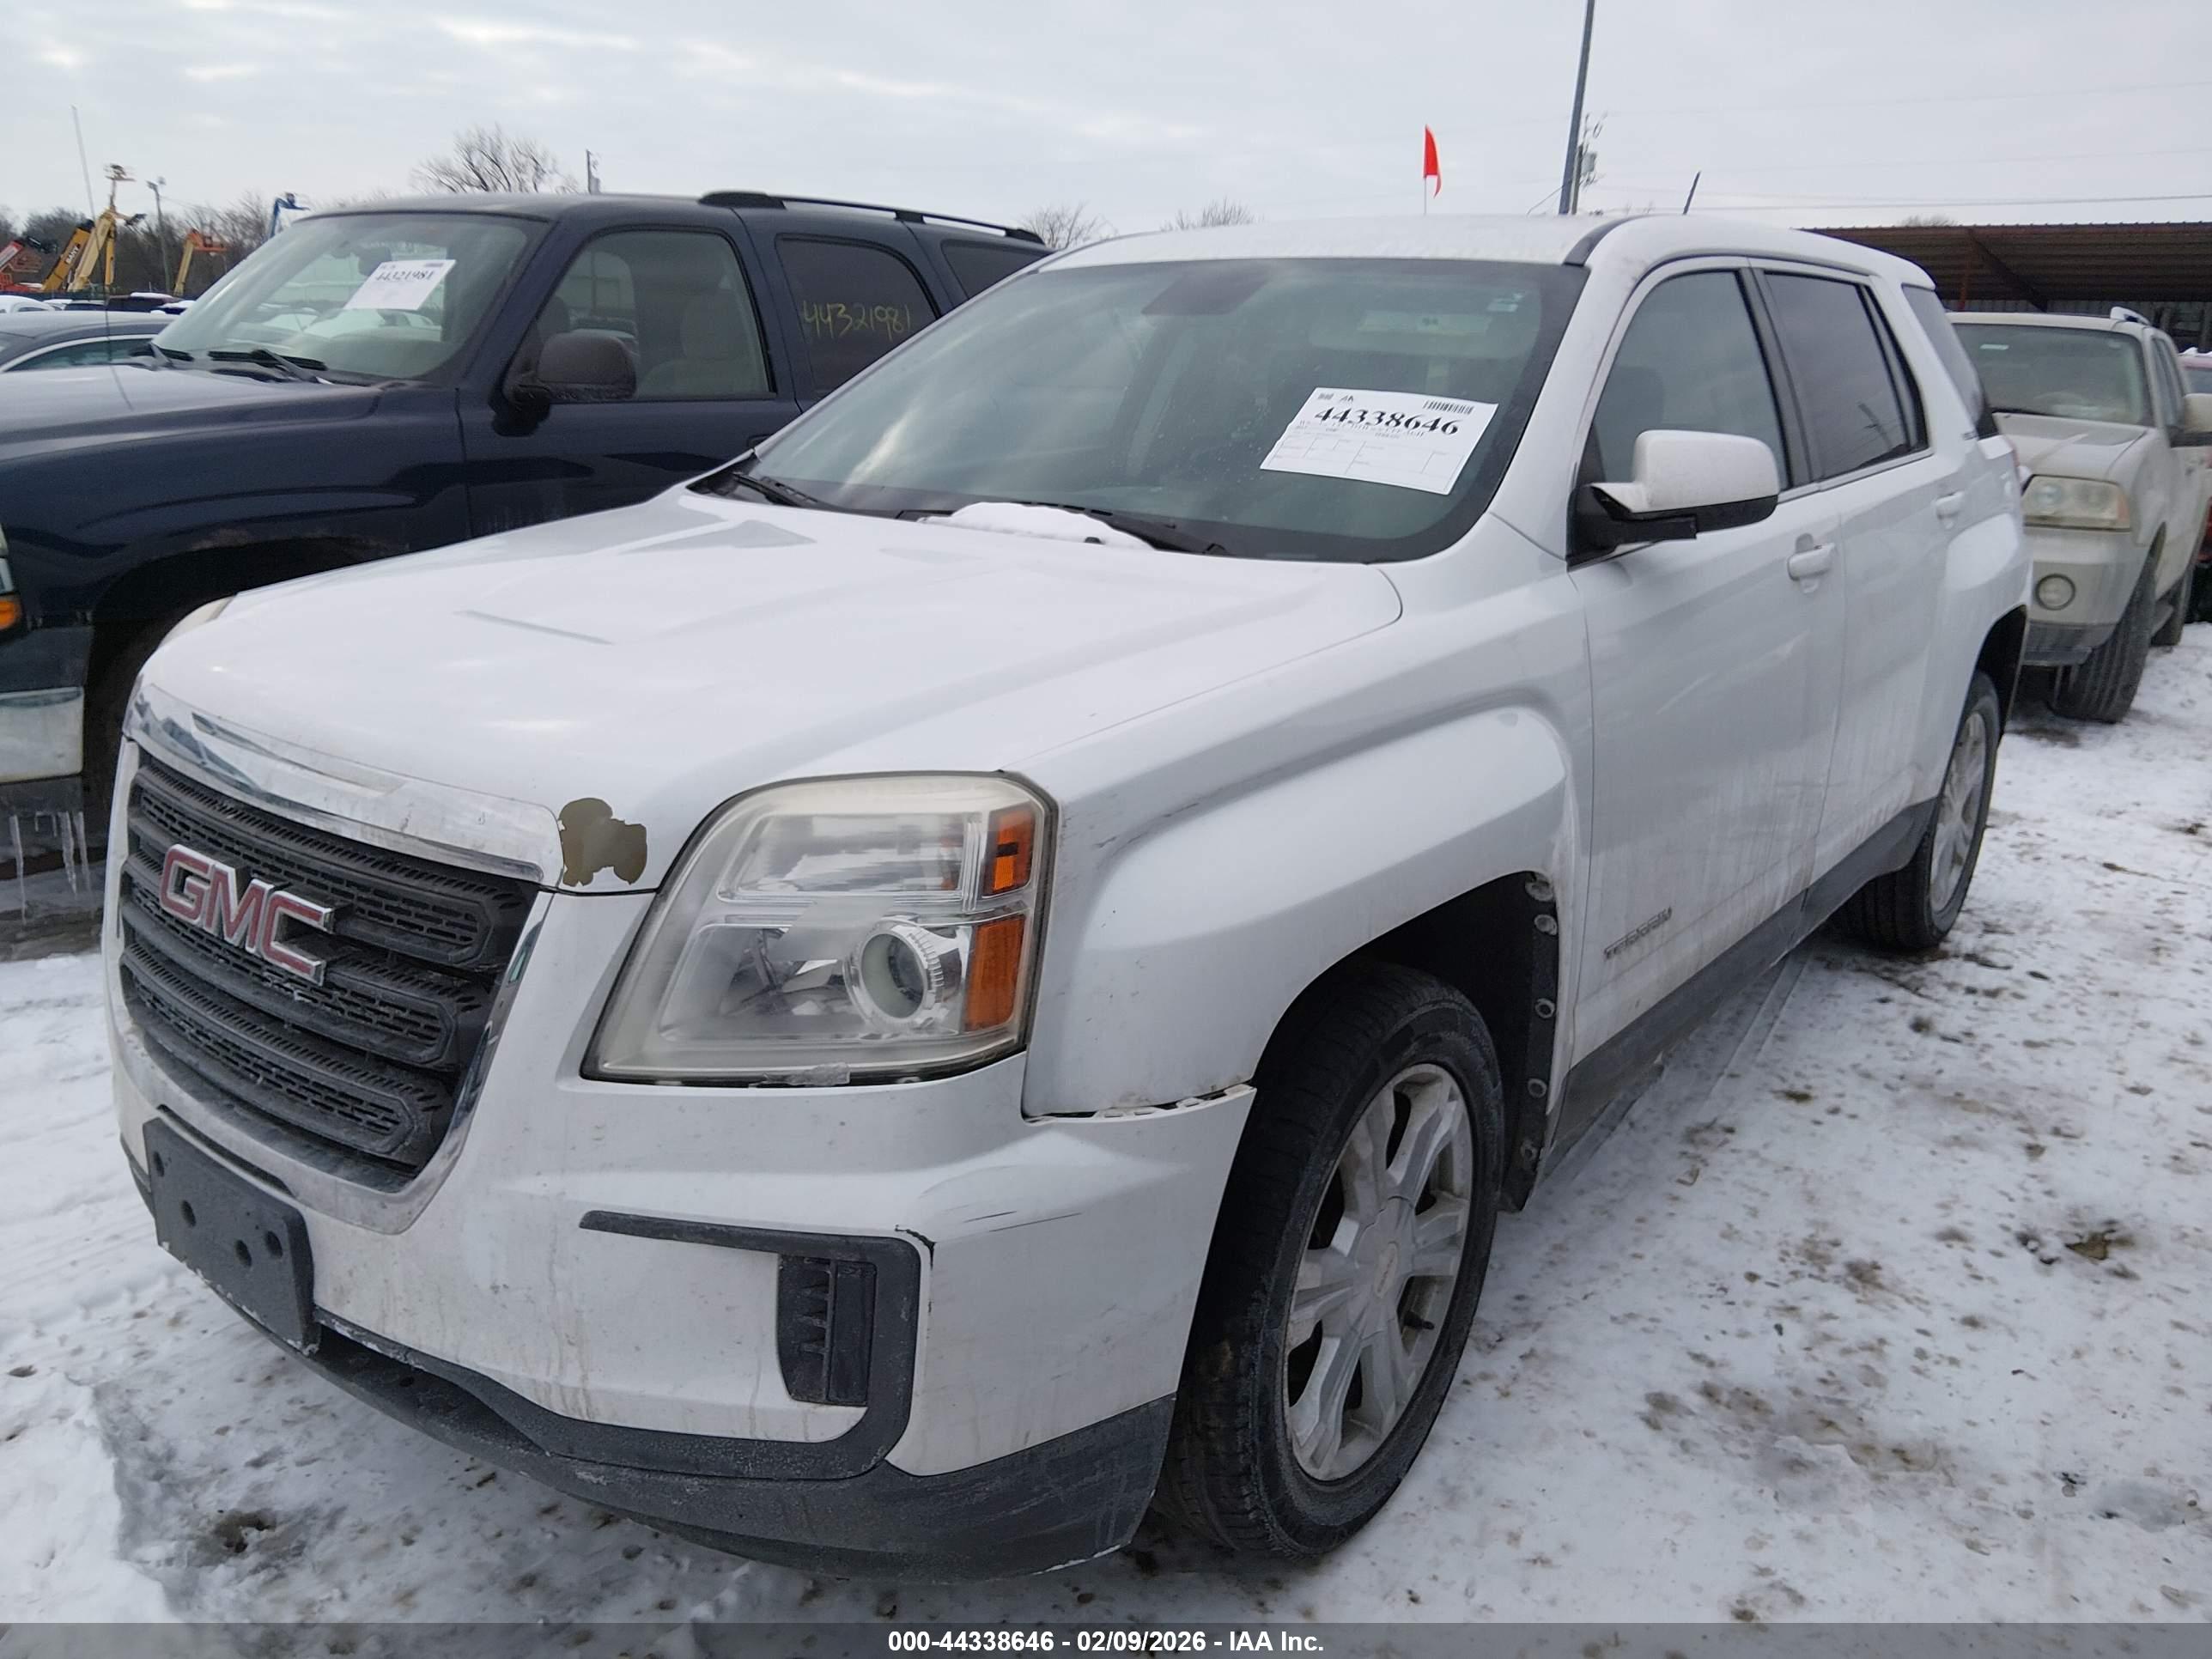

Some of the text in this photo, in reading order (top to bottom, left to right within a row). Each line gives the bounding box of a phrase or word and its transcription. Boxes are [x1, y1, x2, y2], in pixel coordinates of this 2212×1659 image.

[803, 300, 911, 342] 44321981
[1315, 407, 1459, 435] 44338646
[161, 844, 332, 986] GMC
